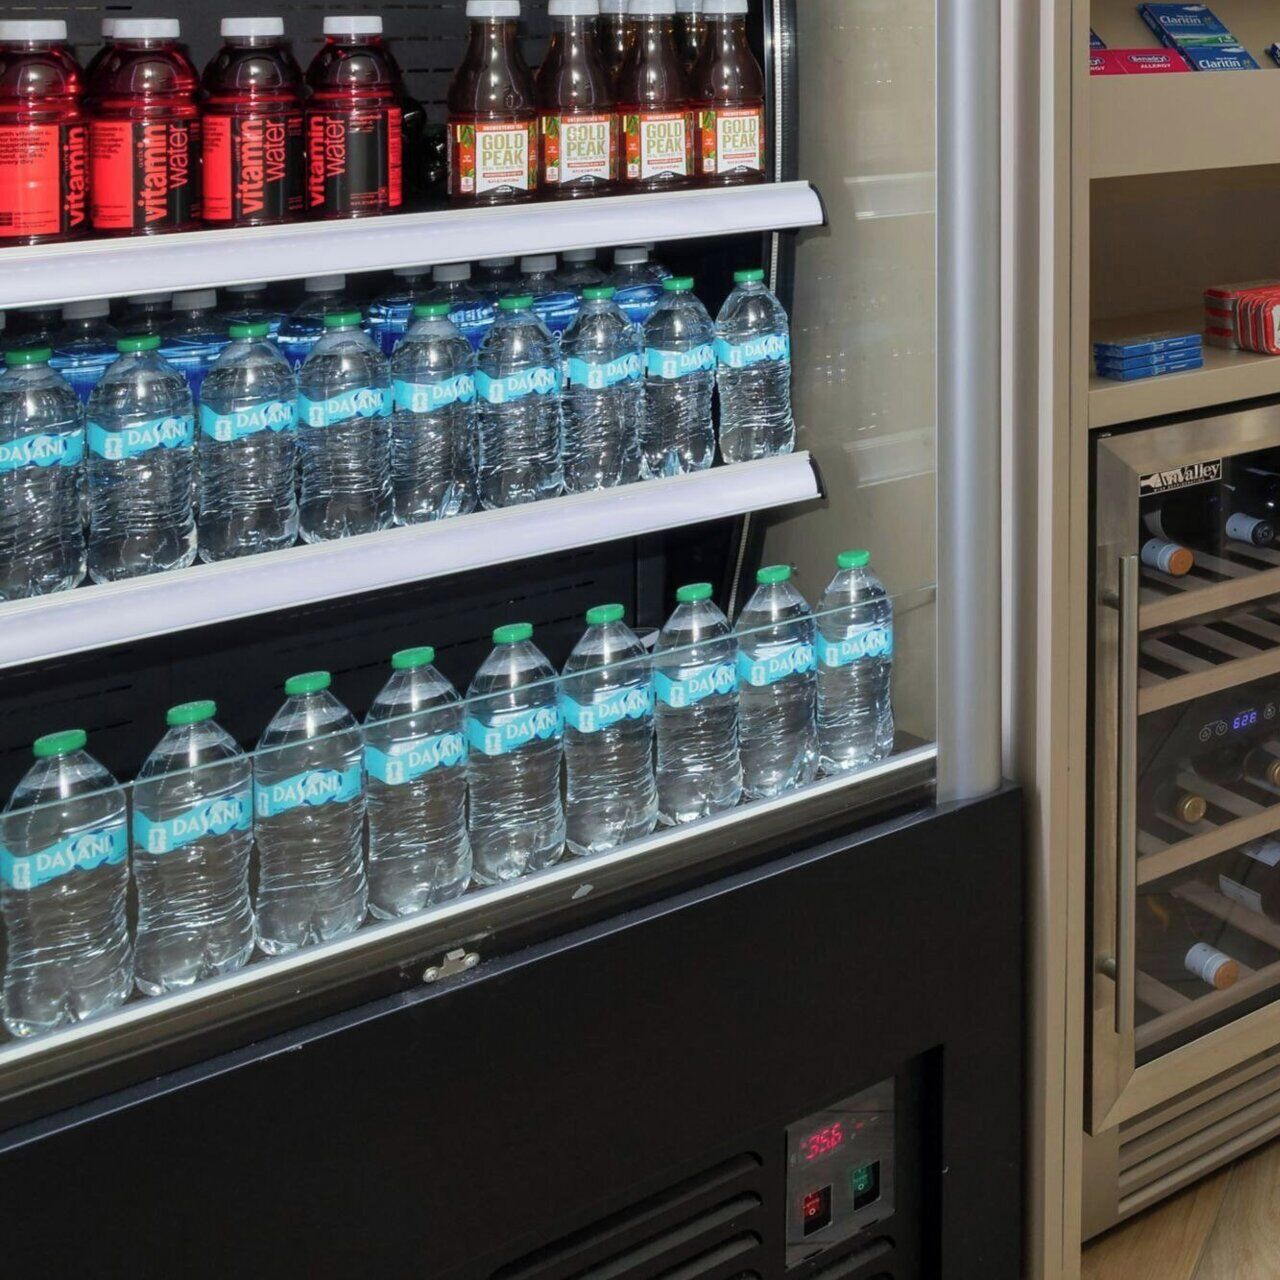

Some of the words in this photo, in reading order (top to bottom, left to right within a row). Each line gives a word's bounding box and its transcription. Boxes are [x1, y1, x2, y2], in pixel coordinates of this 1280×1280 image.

[1159, 15, 1201, 26] Claritin
[1198, 59, 1241, 70] Claritin
[566, 125, 606, 141] GOLD
[646, 123, 682, 139] GOLD
[722, 119, 756, 134] GOLD
[265, 120, 286, 183] water
[324, 116, 346, 177] water
[482, 133, 524, 150] GOLD
[566, 140, 606, 157] PEAK
[646, 138, 683, 153] PEAK
[722, 133, 757, 149] PEAK
[169, 124, 189, 190] water
[236, 119, 265, 214] vitamin
[308, 116, 326, 207] vitamin
[482, 150, 524, 166] PEAK
[63, 126, 85, 227] vitamin
[138, 124, 168, 222] vitamin
[236, 404, 294, 431] DASANI
[328, 391, 384, 417] DASANI
[128, 421, 188, 449] DASANI
[408, 737, 464, 771] DASANI
[272, 773, 342, 806] DASANI
[172, 802, 241, 839] DASANI
[36, 833, 113, 874] DASANI
